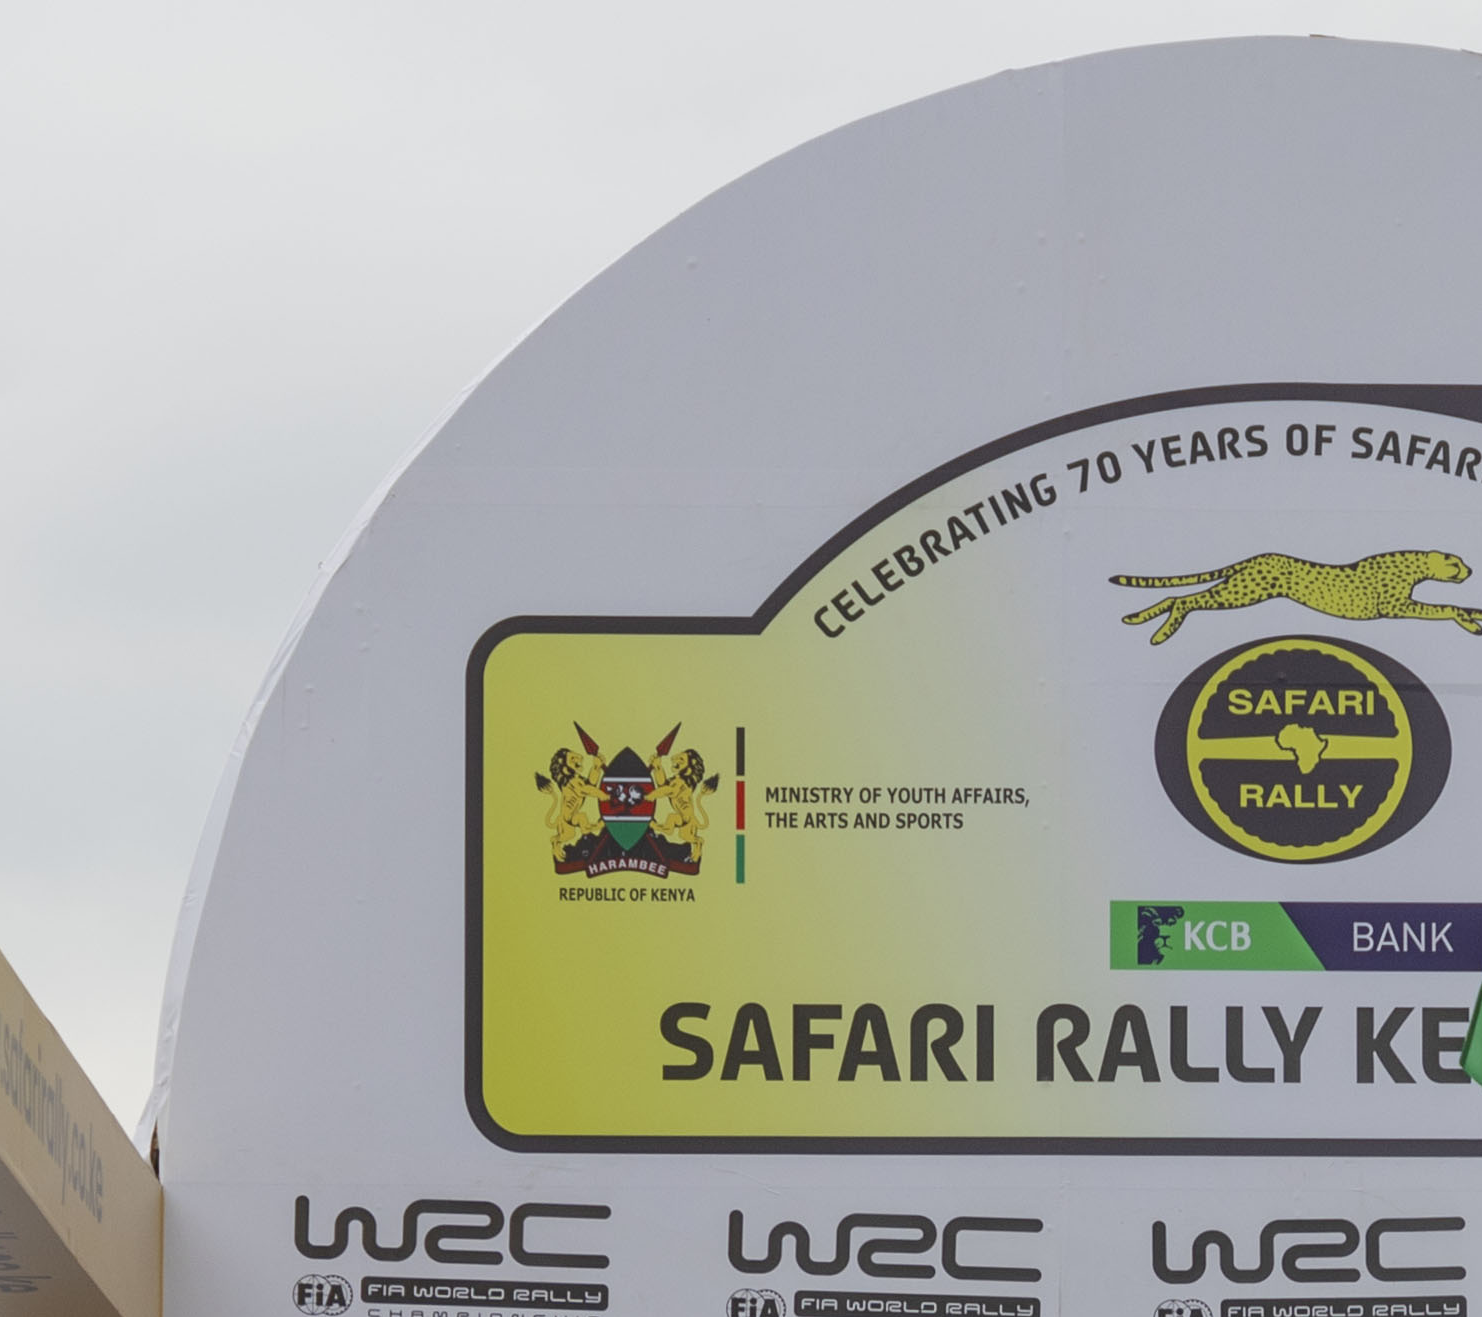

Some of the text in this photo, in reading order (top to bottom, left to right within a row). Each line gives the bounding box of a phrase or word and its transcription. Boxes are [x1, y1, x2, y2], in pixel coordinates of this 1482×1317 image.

[813, 473, 1058, 640] CELEBRATING
[1067, 450, 1123, 494] 70
[1132, 424, 1269, 475] YEARS
[1285, 424, 1337, 457] OF
[1227, 688, 1377, 717] SAFARI
[765, 787, 1031, 808] MINISTRY OF YOUTH AFFAIRS,
[1238, 784, 1365, 810] RALLY
[765, 812, 965, 830] THE ARTS AND SPORTS
[587, 857, 669, 878] HARAMBEE
[559, 887, 696, 903] REPUBLIC OF KENYA
[1183, 919, 1455, 953] KCB BANK
[659, 1001, 998, 1083] SAFARI
[1035, 1002, 1324, 1085] RALLY
[294, 1195, 612, 1269] WRC
[728, 1210, 1043, 1282] WRC
[1152, 1216, 1466, 1284] WRC
[368, 1283, 604, 1304] FIA WORLD RALLY
[801, 1296, 1035, 1317] FIA WORLD RALLY
[1372, 1300, 1461, 1317] RALLY
